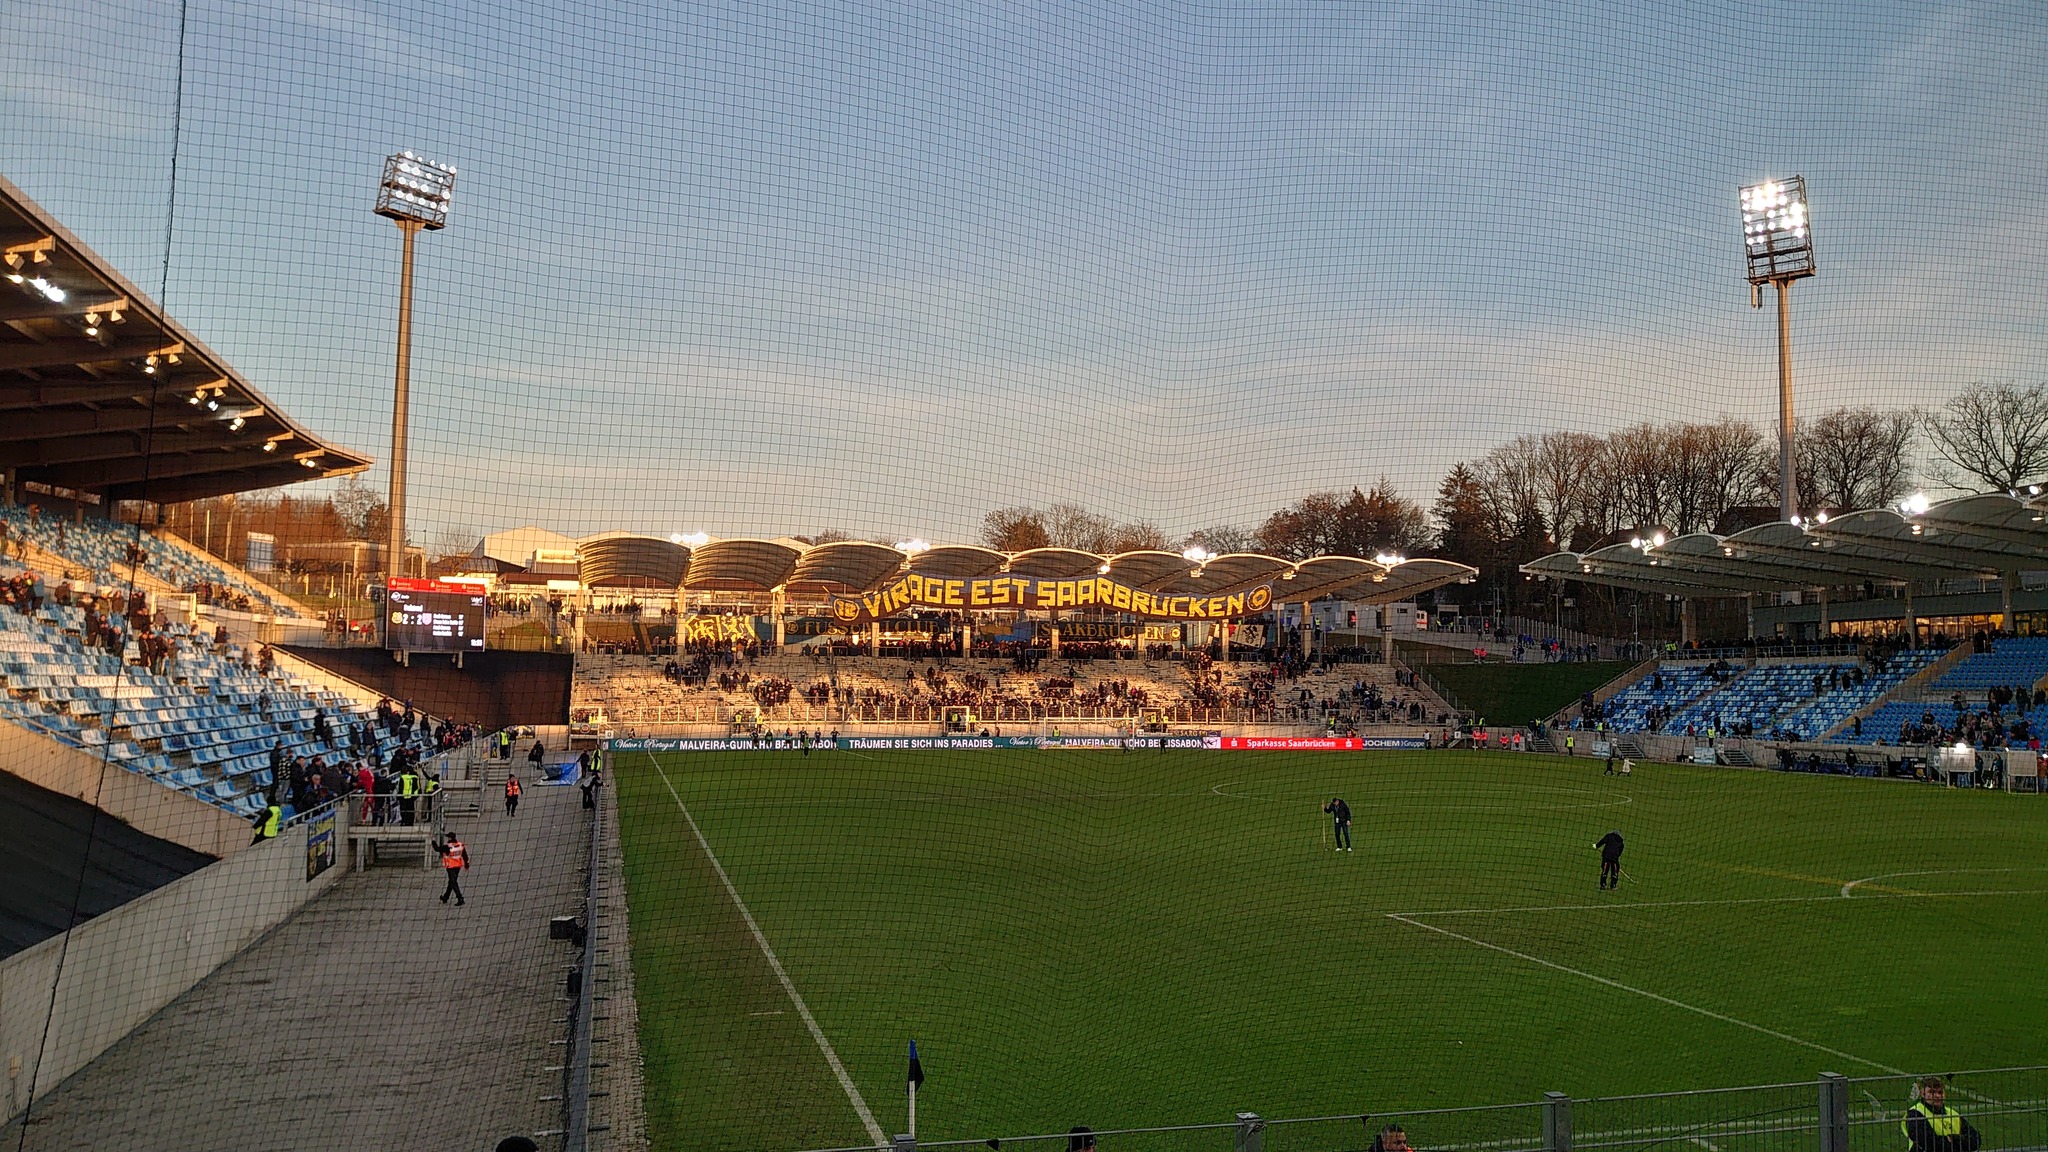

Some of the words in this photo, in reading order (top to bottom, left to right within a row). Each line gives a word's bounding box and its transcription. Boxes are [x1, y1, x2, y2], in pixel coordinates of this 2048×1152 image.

[862, 574, 965, 618] VIRAGE
[970, 577, 1030, 605] EST
[1037, 577, 1245, 617] SAARBRUCKEN
[849, 737, 892, 749] TRÄUMEN
[895, 739, 909, 748] SIE
[911, 739, 932, 748] SICH
[934, 739, 949, 748] INS
[951, 739, 993, 748] PARADIES
[1164, 739, 1203, 748] ISSABON
[1246, 738, 1287, 749] Sparkasse
[1288, 738, 1336, 748] Saarbrücken
[1404, 740, 1425, 748] Gruppe
